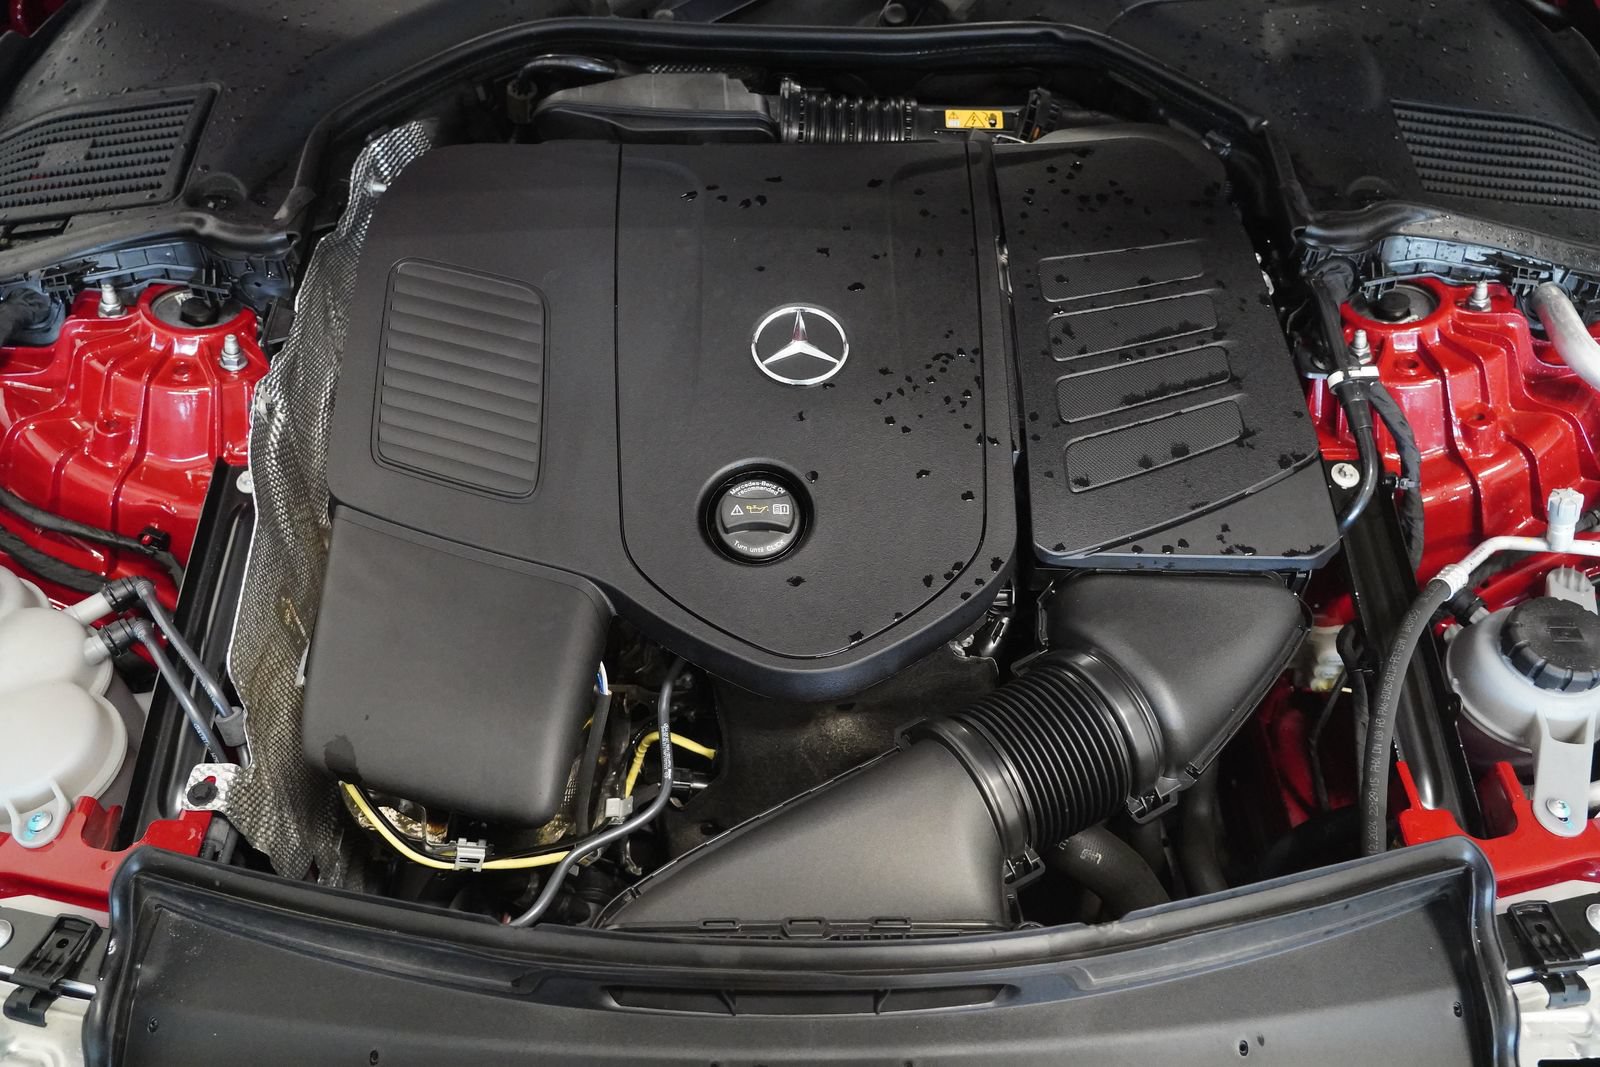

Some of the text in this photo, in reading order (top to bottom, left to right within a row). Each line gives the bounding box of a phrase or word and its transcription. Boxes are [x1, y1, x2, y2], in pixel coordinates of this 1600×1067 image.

[729, 480, 778, 495] Mercedes-Benz
[737, 486, 779, 496] recommended
[734, 540, 748, 551] Turn
[766, 539, 785, 552] CLICK
